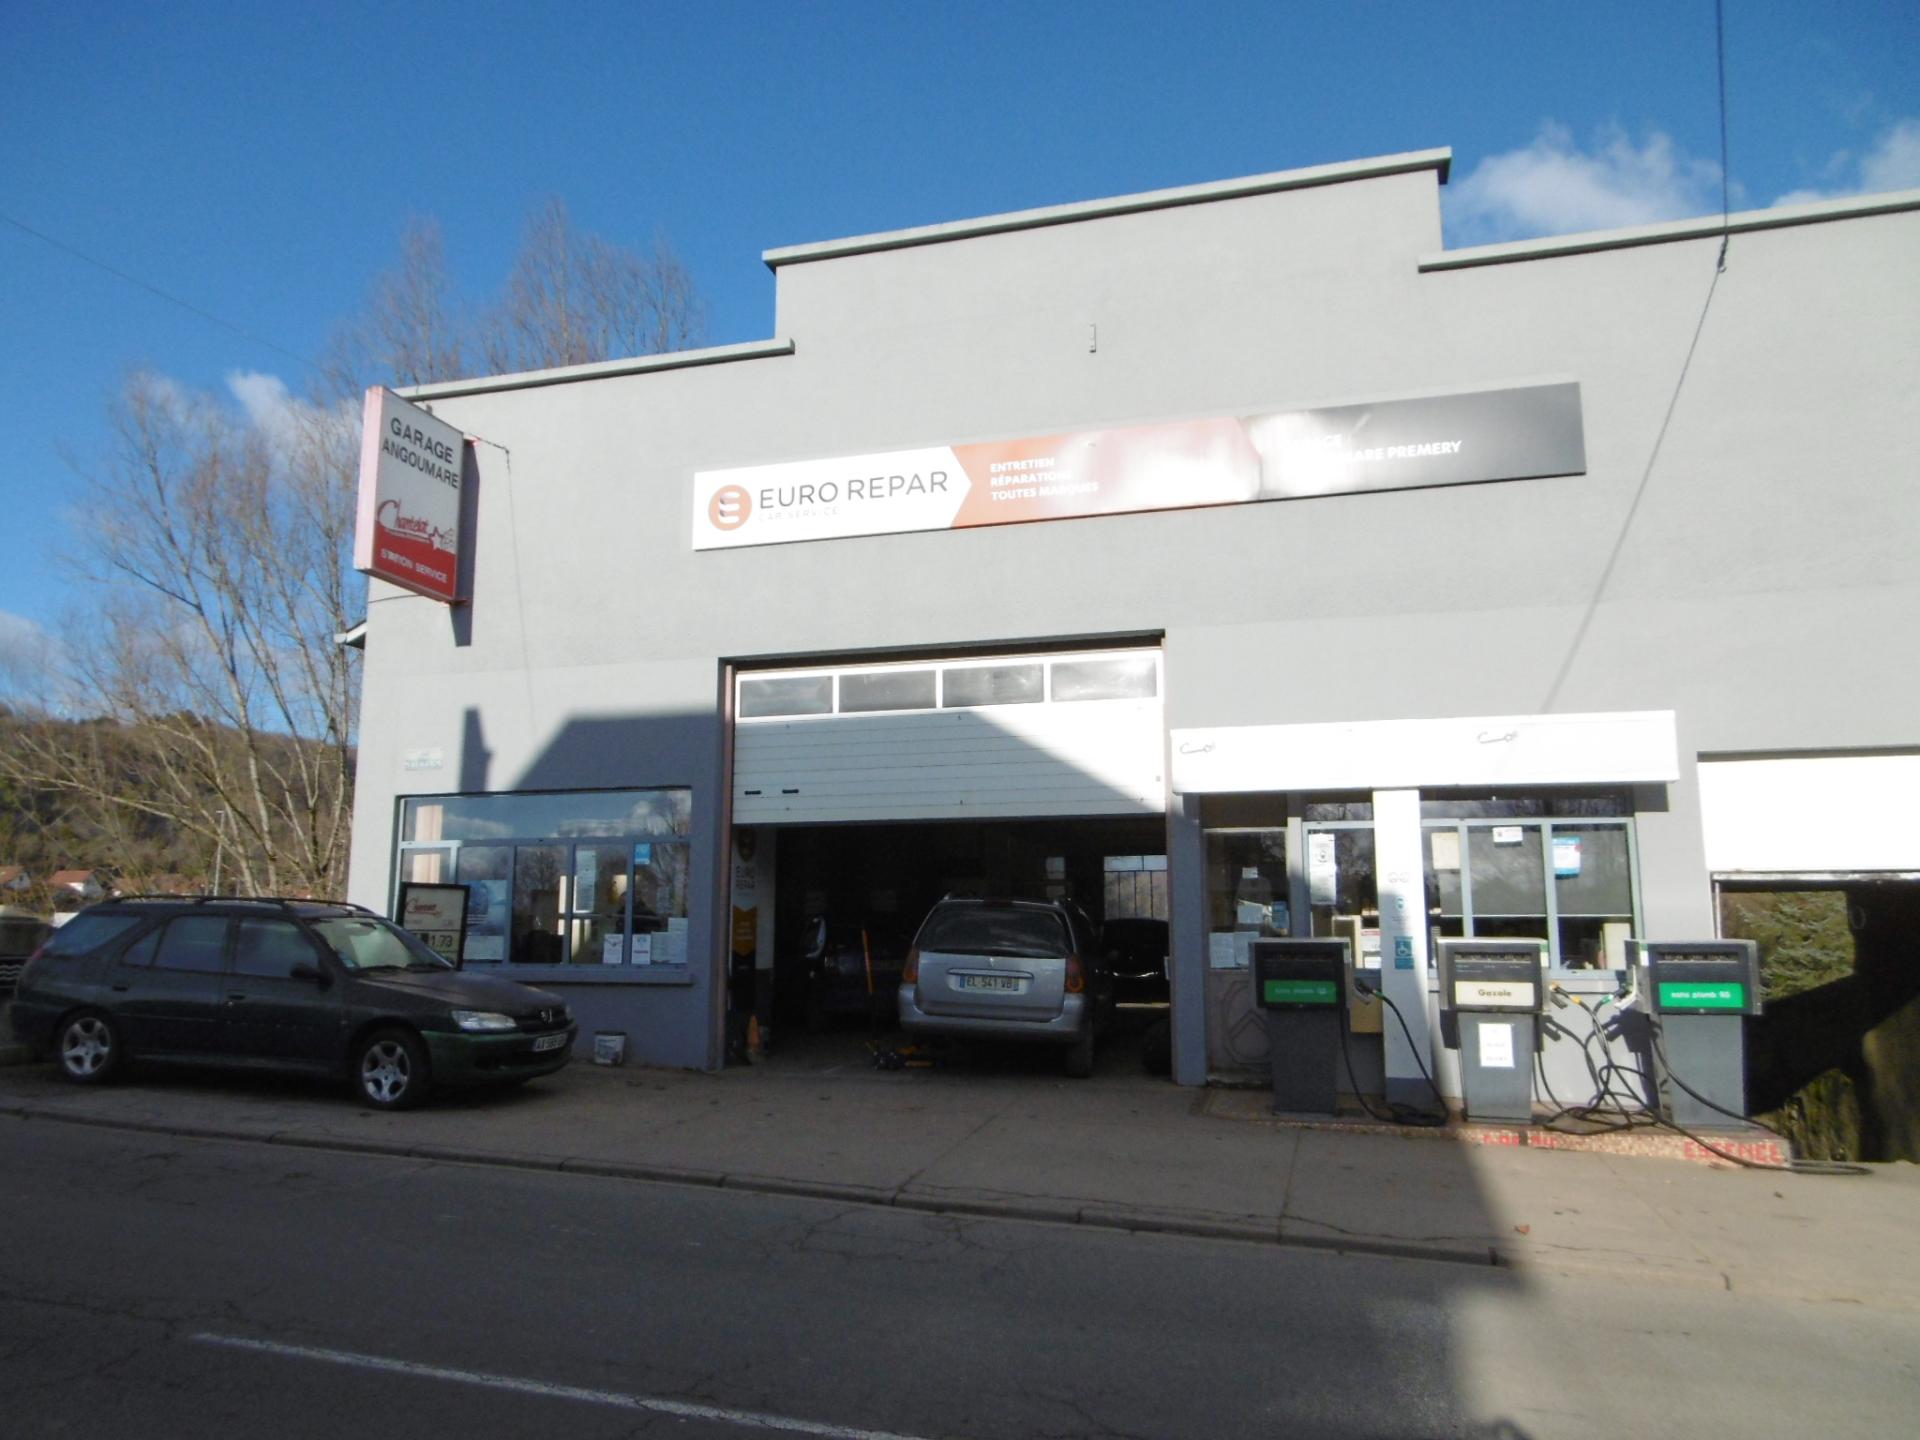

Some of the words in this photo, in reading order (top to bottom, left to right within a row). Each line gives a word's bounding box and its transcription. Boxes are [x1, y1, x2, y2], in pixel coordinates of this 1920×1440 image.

[390, 417, 454, 465] GARAGE
[1387, 440, 1463, 460] PREMERY
[382, 437, 460, 489] ANGOUMARE
[989, 457, 1055, 473] ENTRETIEN
[759, 482, 839, 510] EURO
[847, 470, 949, 501] REPAR
[991, 488, 1037, 501] TOUTES
[380, 548, 414, 569] STATION
[415, 562, 448, 584] SERVICE
[1477, 989, 1512, 998] Gazole
